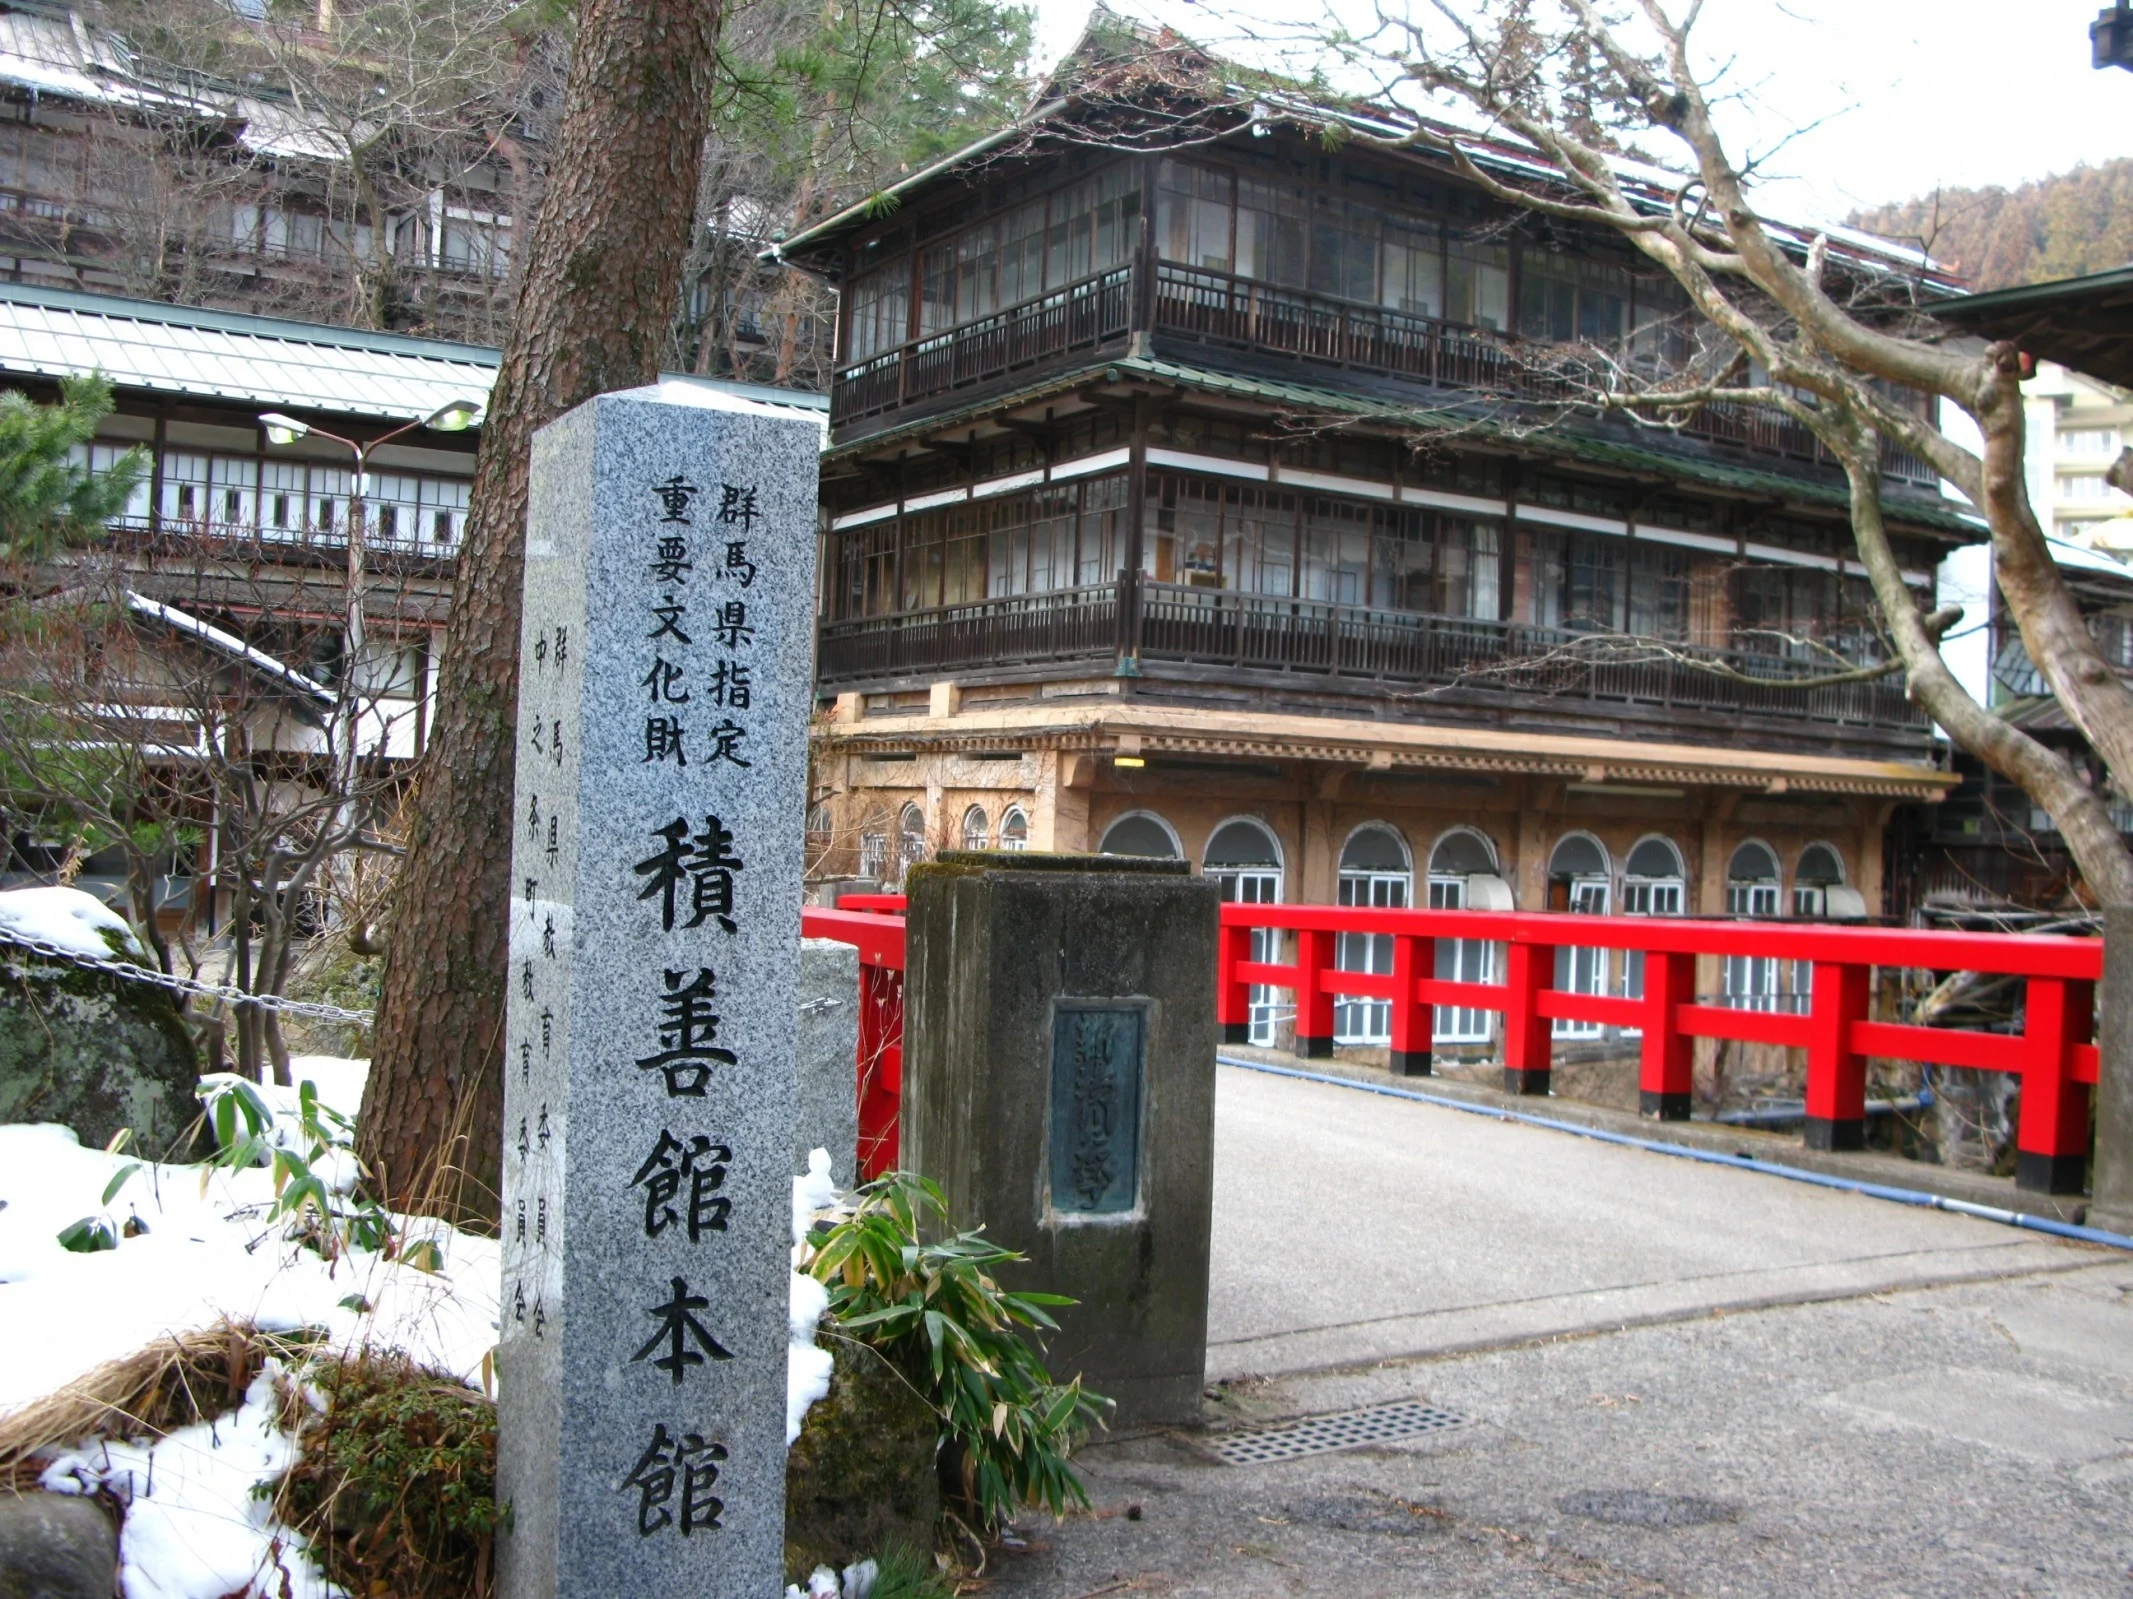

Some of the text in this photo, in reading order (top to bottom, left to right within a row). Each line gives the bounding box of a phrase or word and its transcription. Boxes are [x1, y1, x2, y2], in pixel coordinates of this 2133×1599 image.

[640, 475, 699, 768] 重要文化財
[703, 481, 762, 769] 群馬県指定
[618, 814, 744, 1539] 積善館本館
